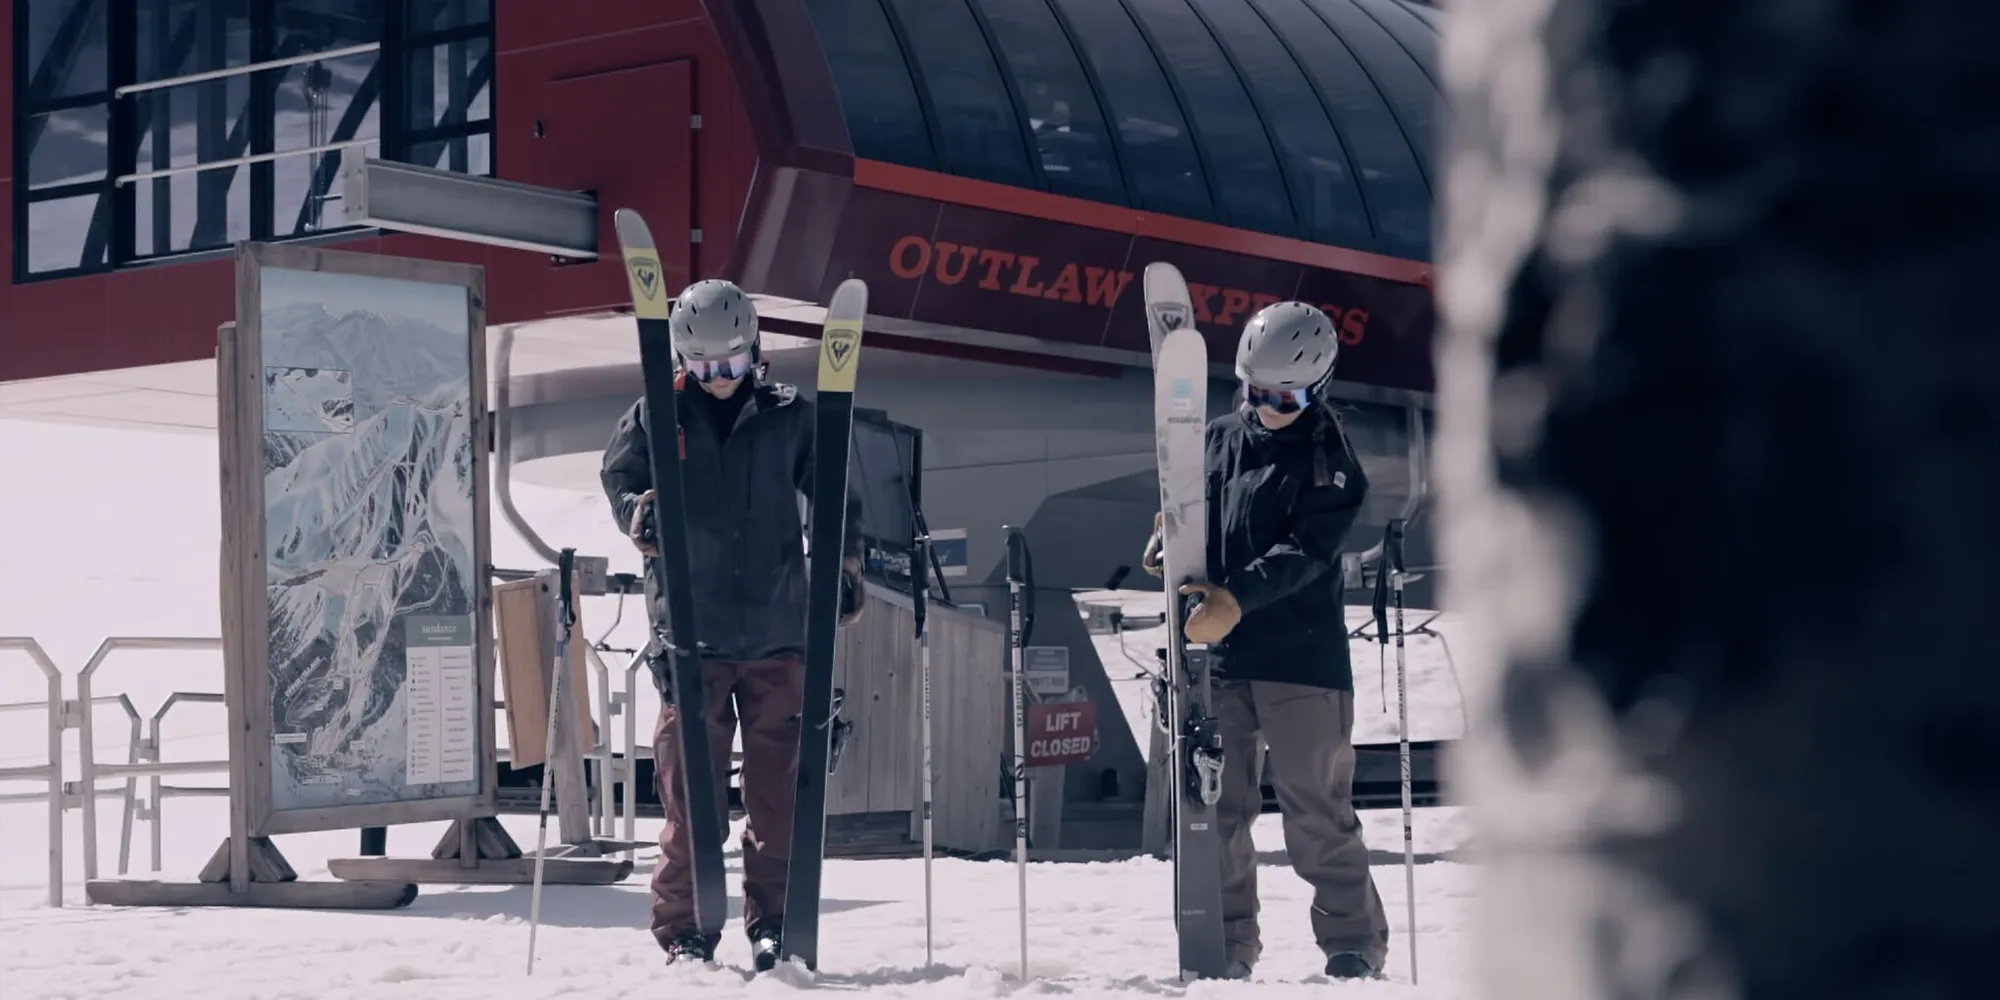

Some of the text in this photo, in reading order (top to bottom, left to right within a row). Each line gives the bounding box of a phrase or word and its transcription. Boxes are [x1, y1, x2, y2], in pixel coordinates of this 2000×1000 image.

[889, 236, 1134, 308] OUTLAW
[1046, 711, 1081, 732] LIFT
[1031, 736, 1090, 758] CLOSED
